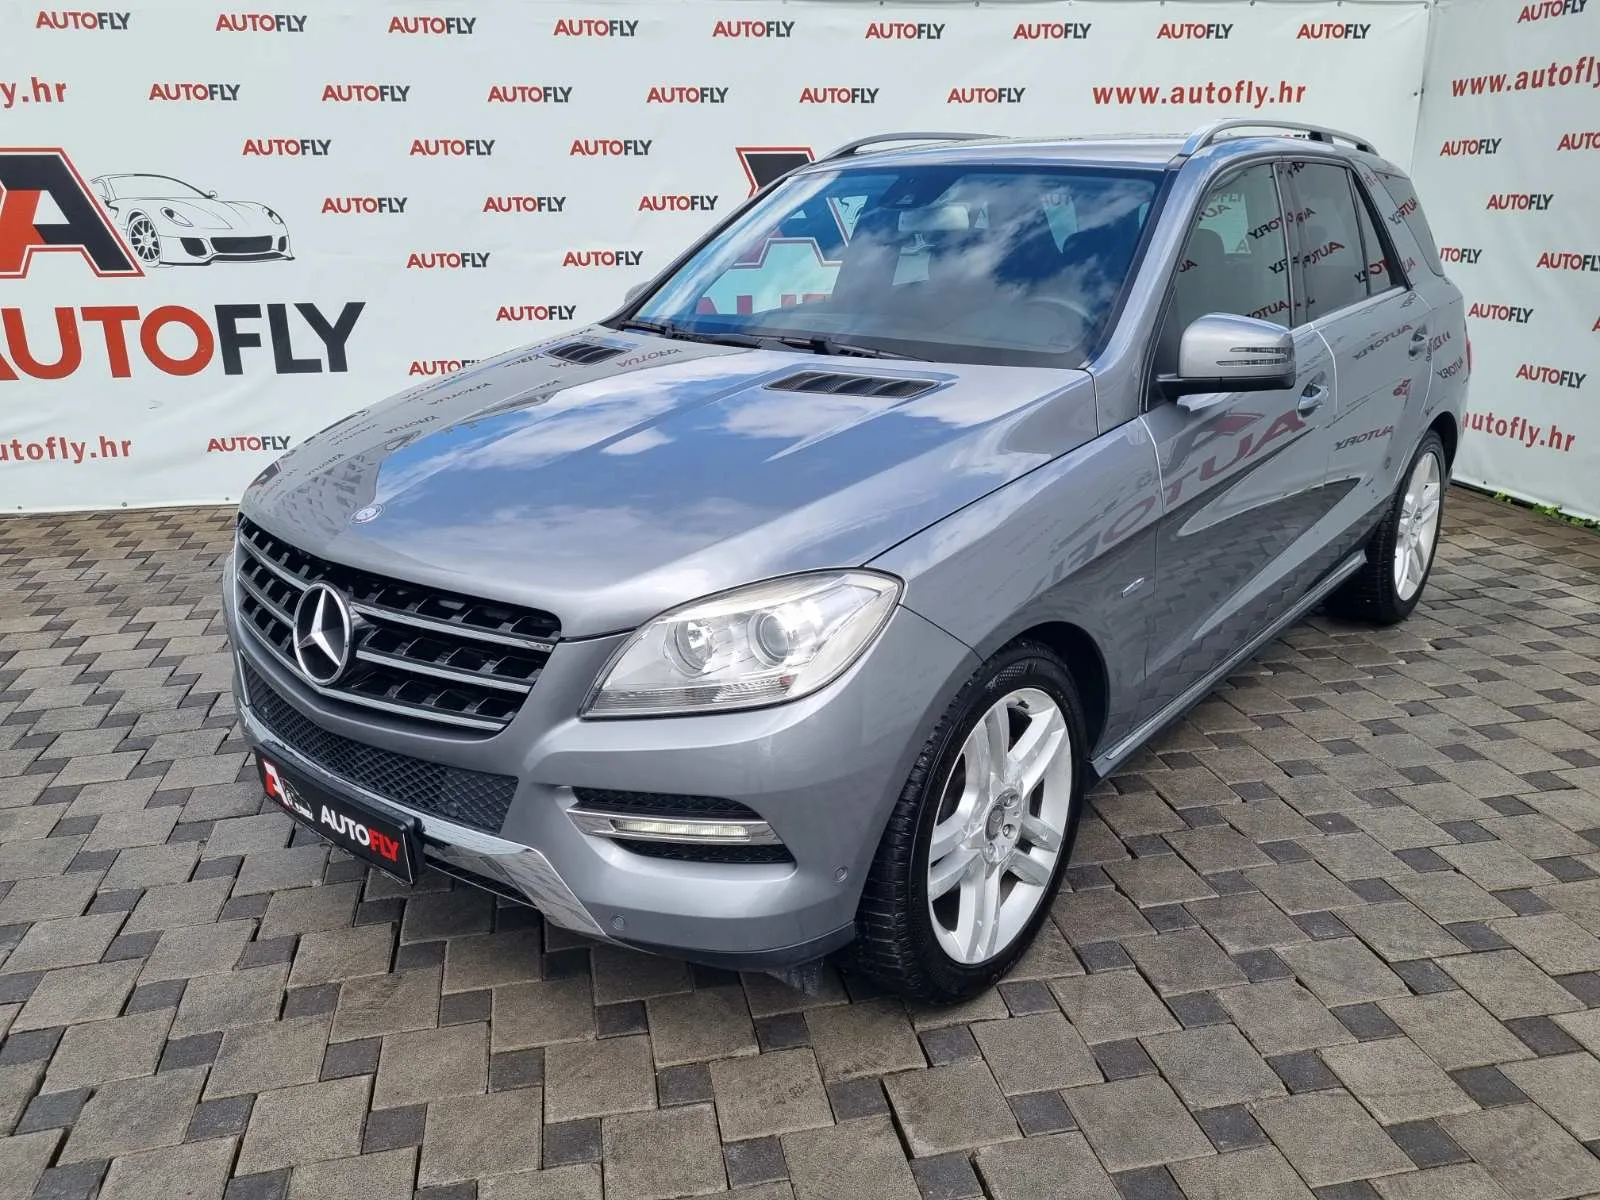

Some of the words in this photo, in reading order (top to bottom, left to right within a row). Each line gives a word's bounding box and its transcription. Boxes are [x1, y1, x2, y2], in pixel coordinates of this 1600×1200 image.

[36, 10, 131, 30] AUTOFLY
[1517, 0, 1588, 24] AUTOFLY
[215, 14, 308, 33] AUTOFLY
[388, 16, 477, 35] AUTOFLY
[553, 19, 639, 37] AUTOFLY
[712, 20, 795, 38] AUTOFLY
[865, 22, 946, 40] AUTOFLY
[1013, 22, 1092, 40] AUTOFLY
[1156, 23, 1234, 40] AUTOFLY
[1296, 23, 1371, 40] AUTOFLY
[148, 83, 241, 101] AUTOFLY
[321, 84, 411, 102] AUTOFLY
[487, 85, 573, 103] AUTOFLY
[646, 87, 729, 104] AUTOFLY
[799, 87, 880, 104] AUTOFLY
[947, 87, 1026, 104] AUTOFLY
[1092, 79, 1306, 109] www.autofly.hr
[242, 139, 332, 156] AUTOFLY
[409, 139, 496, 156] AUTOFLY
[569, 139, 653, 156] AUTOFLY
[1439, 138, 1502, 157] AUTOFLY
[321, 197, 408, 214] AUTOFLY
[482, 196, 567, 213] AUTOFLY
[638, 195, 719, 212] AUTOFLY
[1486, 193, 1554, 211] AUTOFLY
[406, 252, 491, 269] AUTOFLY
[562, 250, 644, 267] AUTOFLY
[495, 304, 577, 322] AUTOFLY
[1468, 303, 1534, 324] AUTOFLY
[1515, 364, 1587, 389] AUTOFLY
[207, 435, 291, 452] AUTOFLY
[320, 804, 400, 861] AUTOFLY
